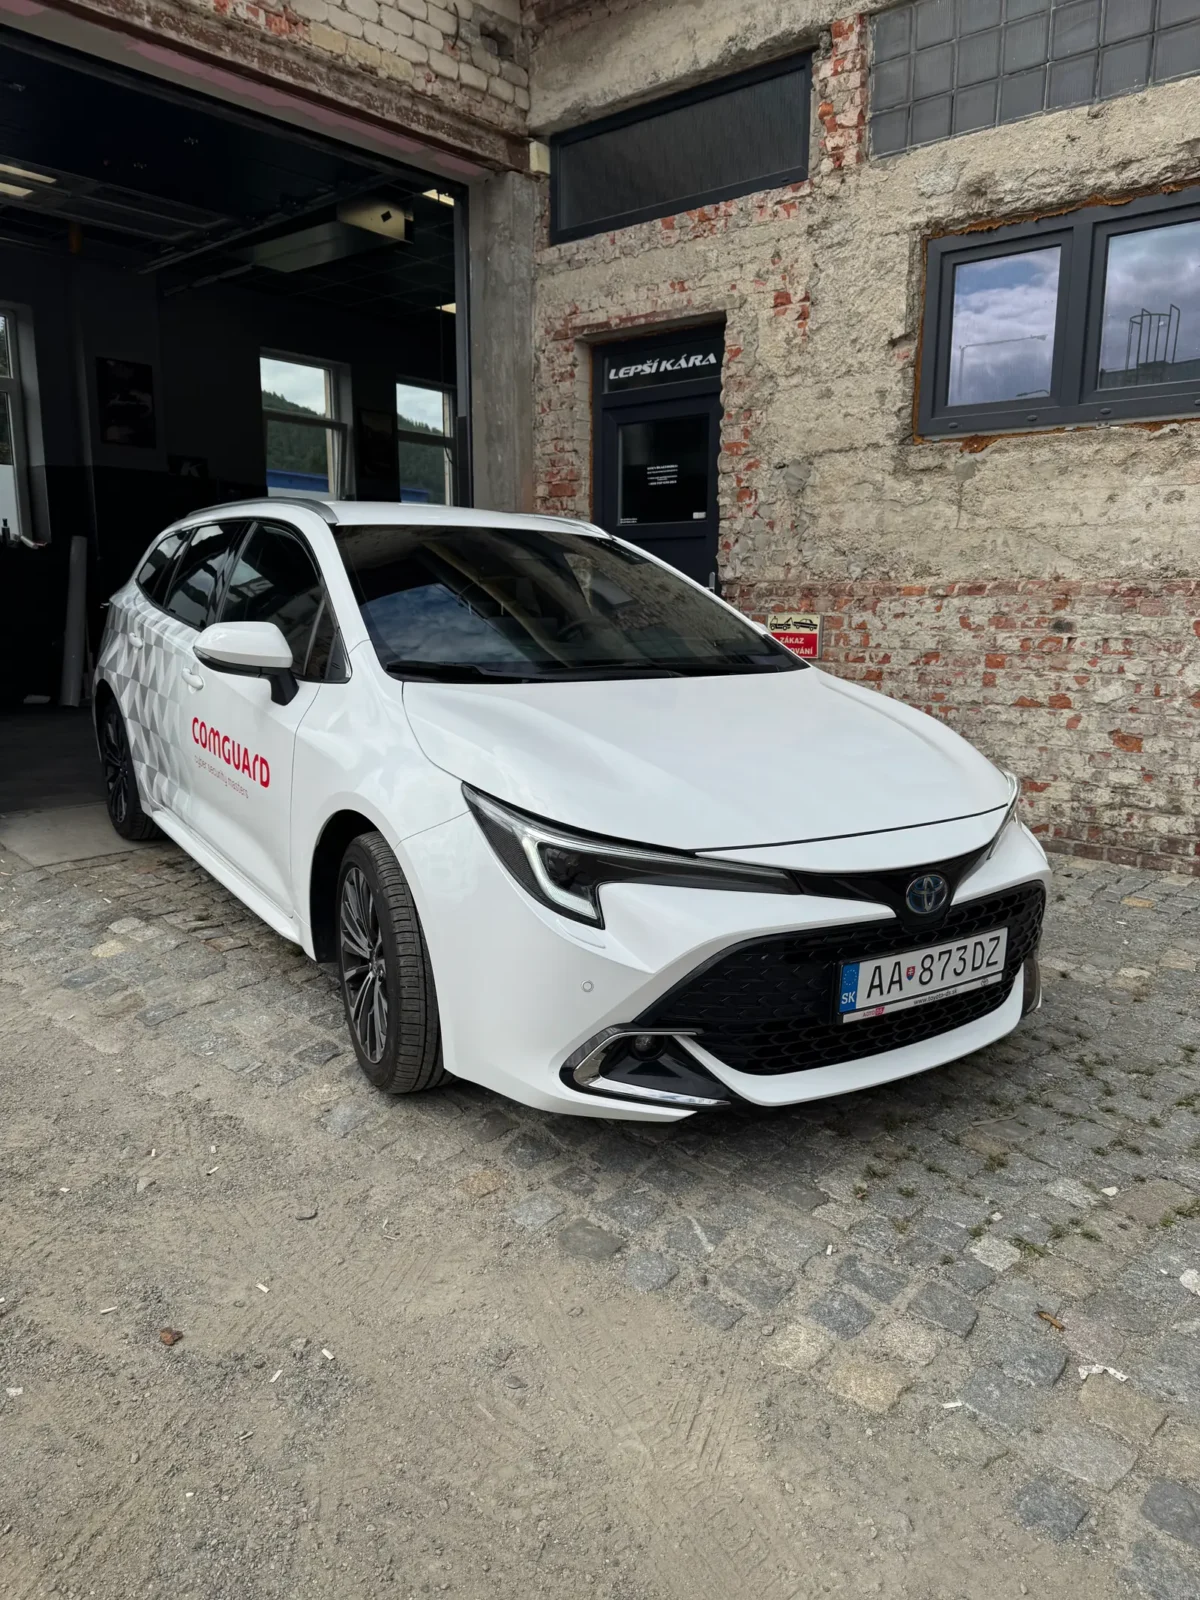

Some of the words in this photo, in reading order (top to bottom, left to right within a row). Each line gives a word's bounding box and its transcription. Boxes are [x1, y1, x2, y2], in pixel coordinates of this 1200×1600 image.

[609, 358, 660, 380] LEPŠÍ
[659, 353, 717, 372] KÁRA
[779, 636, 804, 644] ZÁKAZ
[790, 646, 813, 655] OVÁNÍ
[207, 763, 228, 787] security
[227, 777, 249, 799] masters
[866, 961, 903, 999] AA
[918, 935, 1001, 986] 873DZ
[841, 990, 855, 1005] SK
